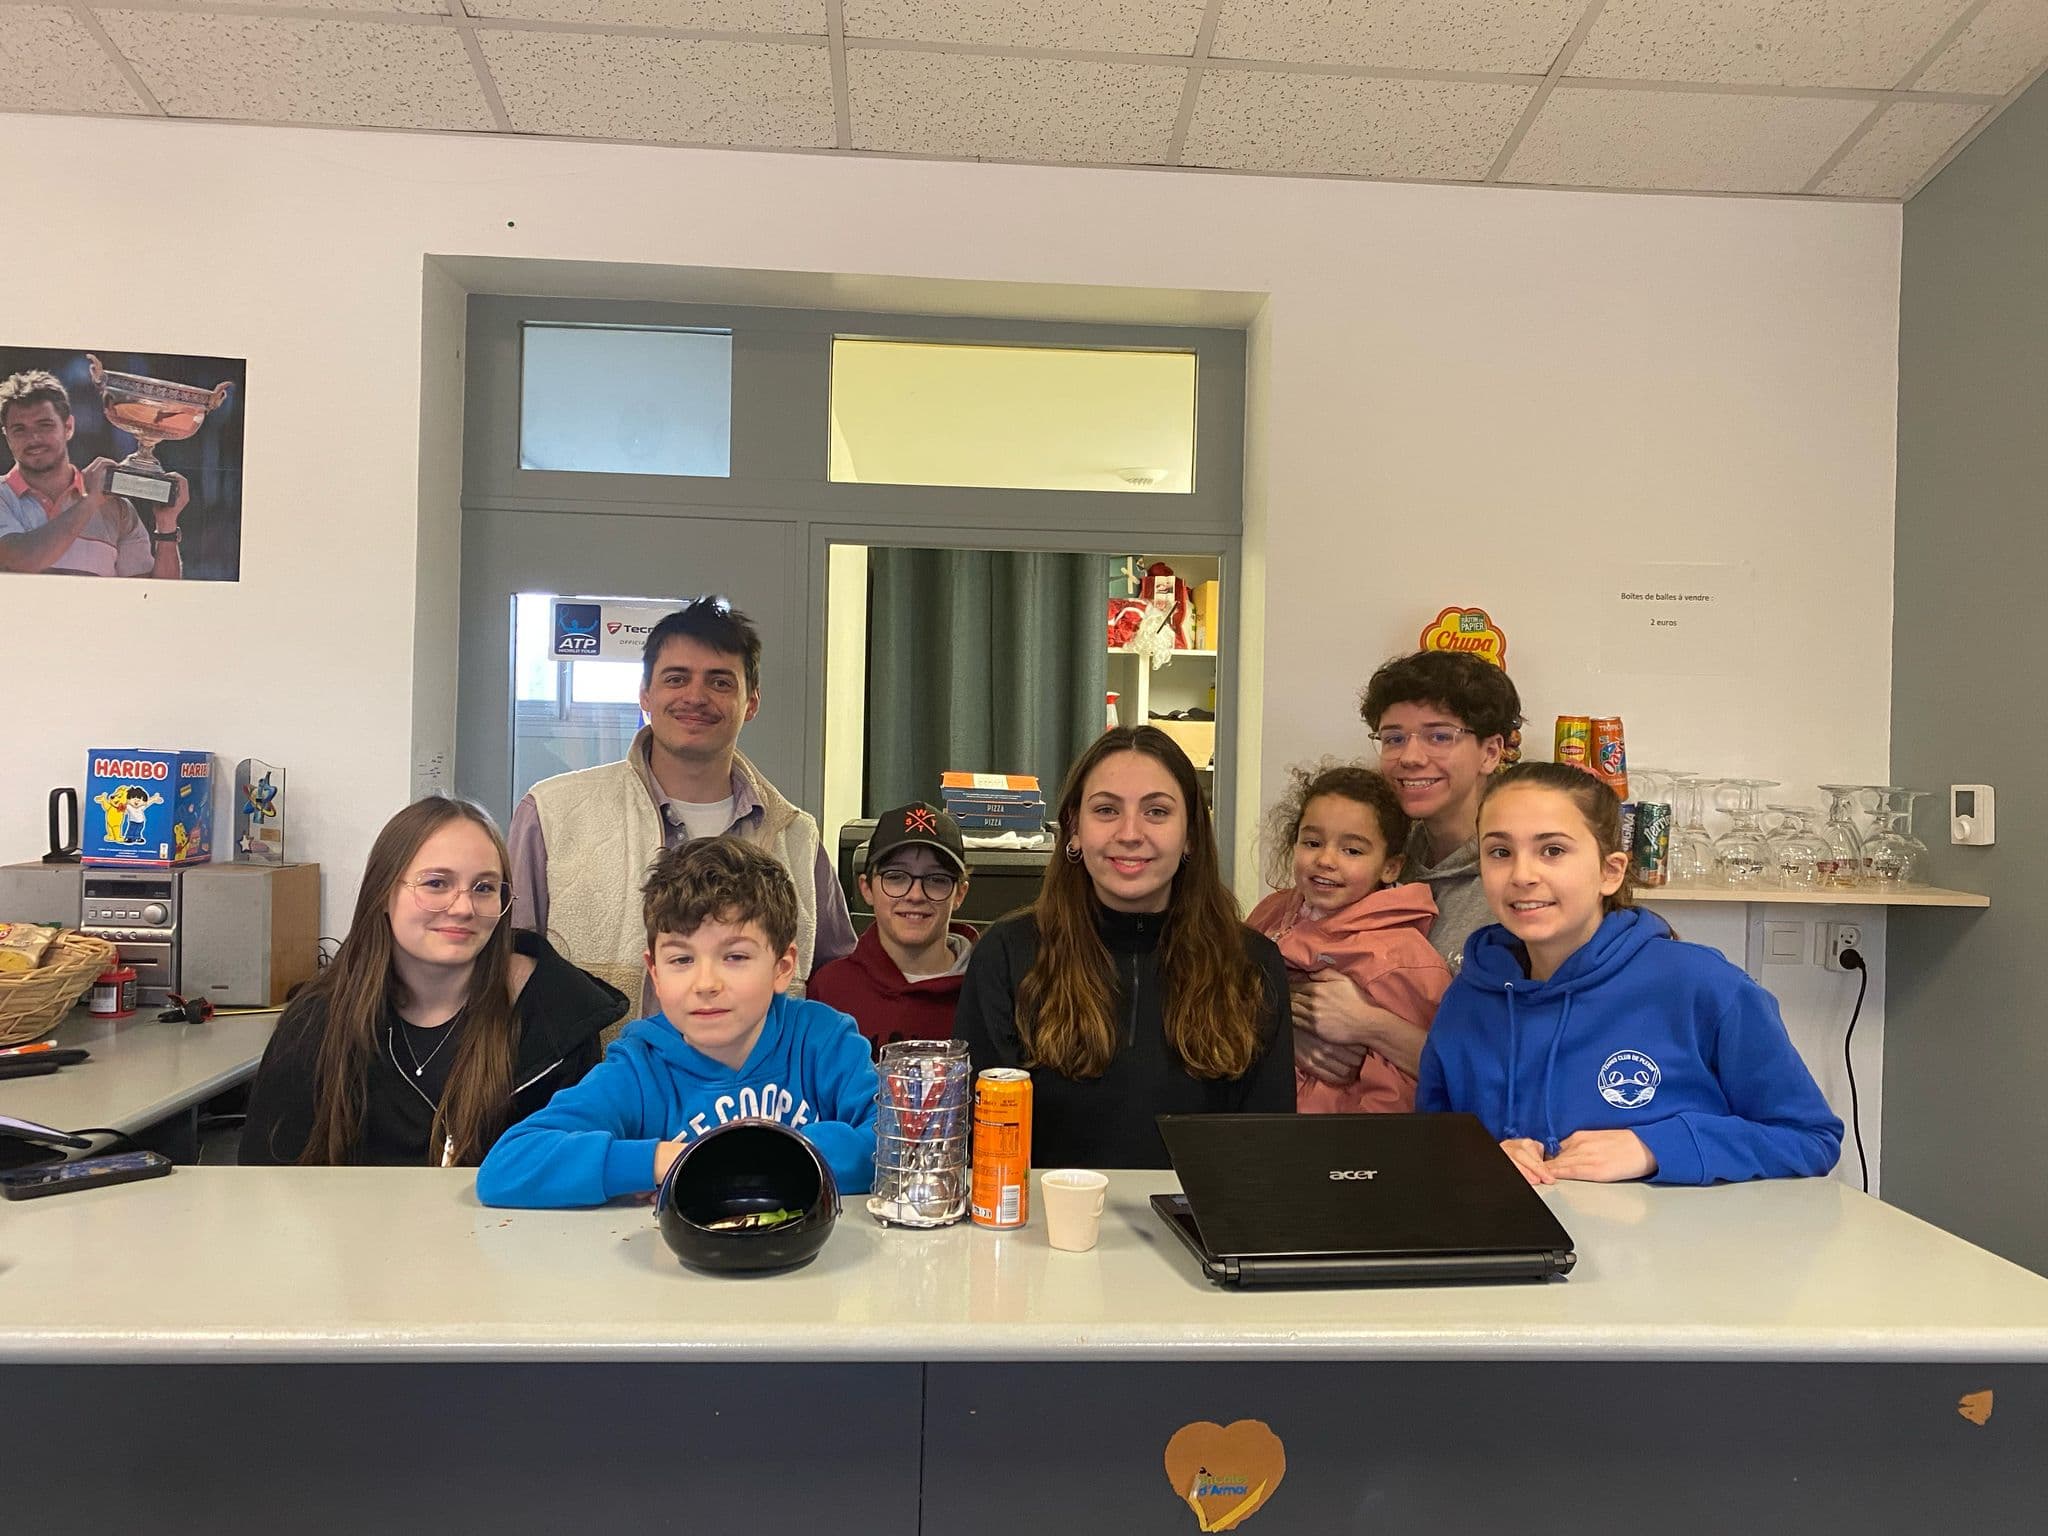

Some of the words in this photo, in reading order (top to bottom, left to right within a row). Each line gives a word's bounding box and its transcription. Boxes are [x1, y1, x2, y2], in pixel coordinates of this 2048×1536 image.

[1655, 593, 1677, 601] balles
[1461, 622, 1486, 631] PAPIER
[1650, 618, 1655, 626] 2
[624, 624, 655, 634] Tecn
[559, 638, 597, 649] ATP
[1436, 630, 1494, 652] Chupa
[96, 760, 168, 778] HARIBO
[182, 763, 209, 777] HARIB
[987, 804, 1005, 813] PIZZA
[984, 818, 1003, 827] PIZZA
[1617, 1054, 1632, 1062] CLUB
[1631, 1054, 1640, 1062] DE
[715, 1083, 819, 1128] COOPE
[1329, 1170, 1378, 1180] acer
